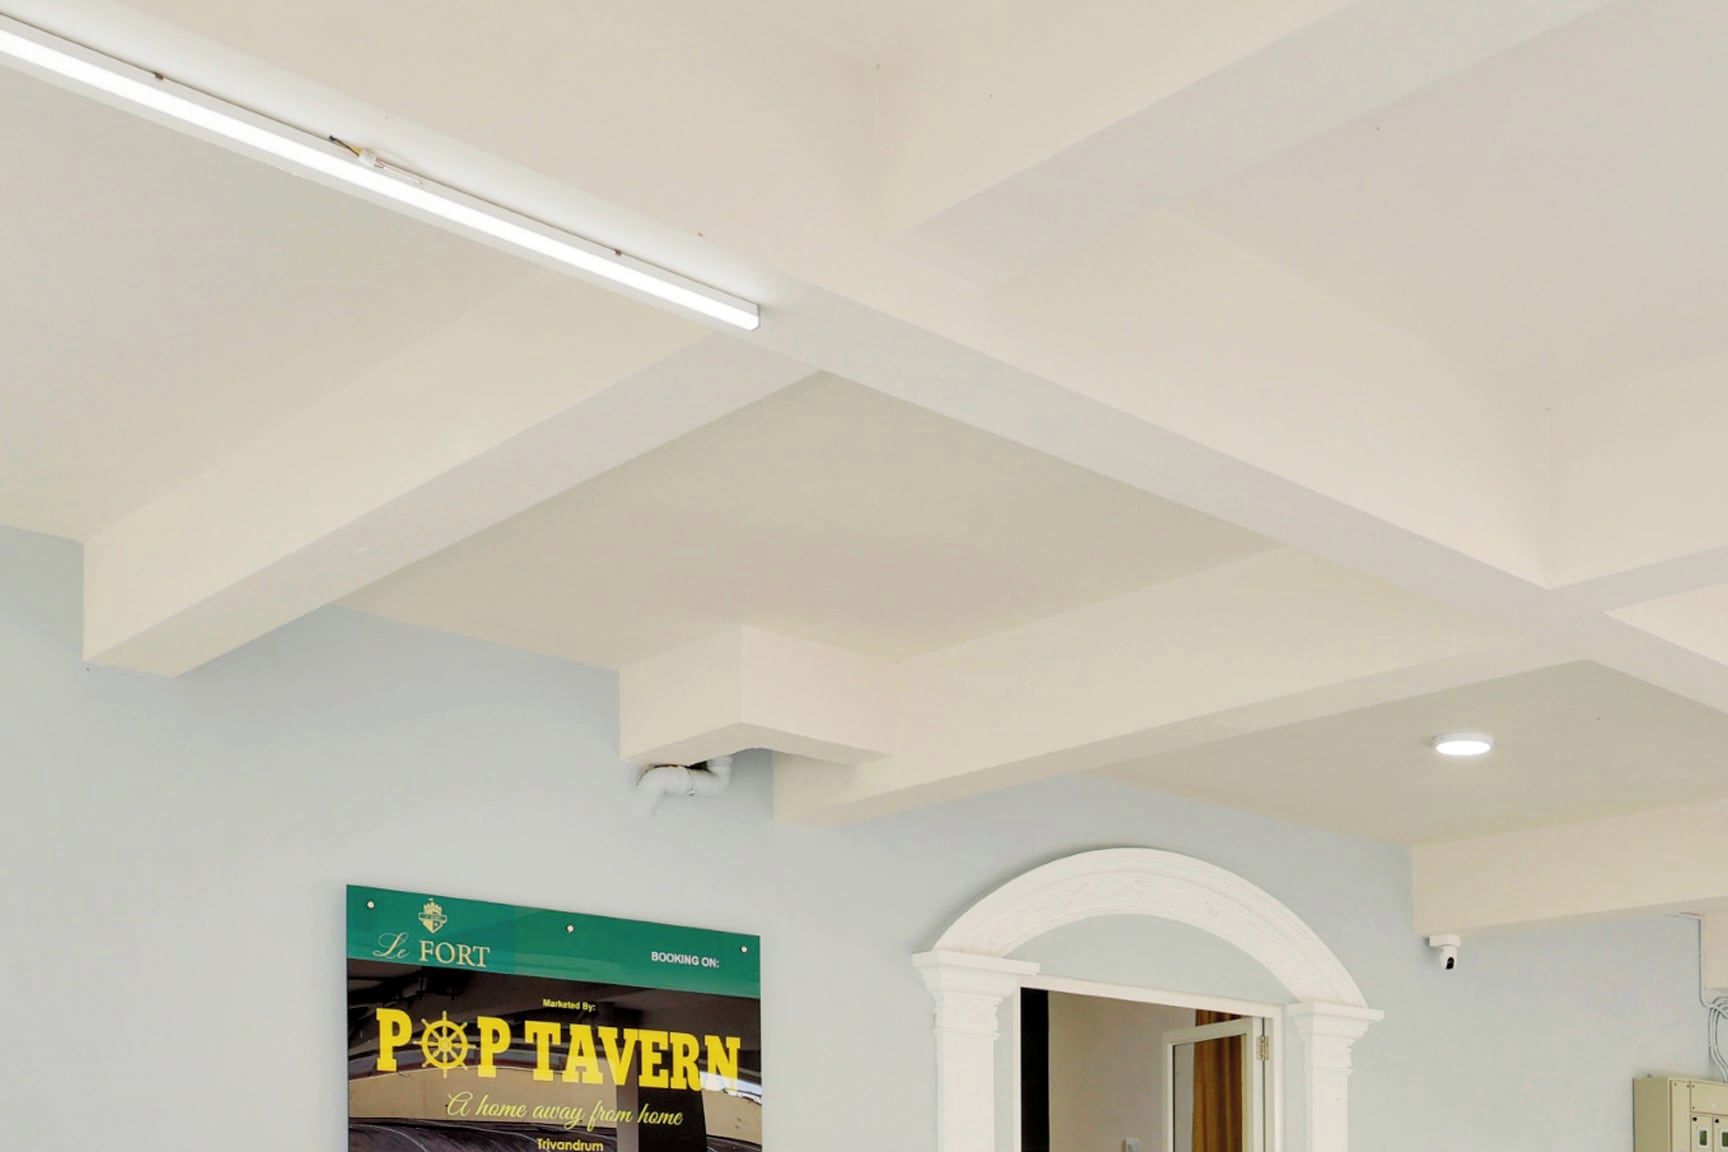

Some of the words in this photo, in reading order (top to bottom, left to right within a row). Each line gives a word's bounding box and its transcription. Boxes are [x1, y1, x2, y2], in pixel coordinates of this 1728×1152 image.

[372, 932, 410, 960] Le
[419, 940, 491, 968] FORT
[651, 951, 699, 966] BOOKING
[701, 957, 720, 969] ON:
[543, 998, 580, 1010] Marketed
[582, 1002, 596, 1013] By:
[524, 1020, 741, 1092] TAVERN
[447, 1092, 474, 1117] A
[475, 1095, 527, 1118] home
[533, 1105, 584, 1130] away
[589, 1100, 632, 1132] from
[637, 1104, 683, 1126] home
[537, 1138, 604, 1152] Trivandrum
